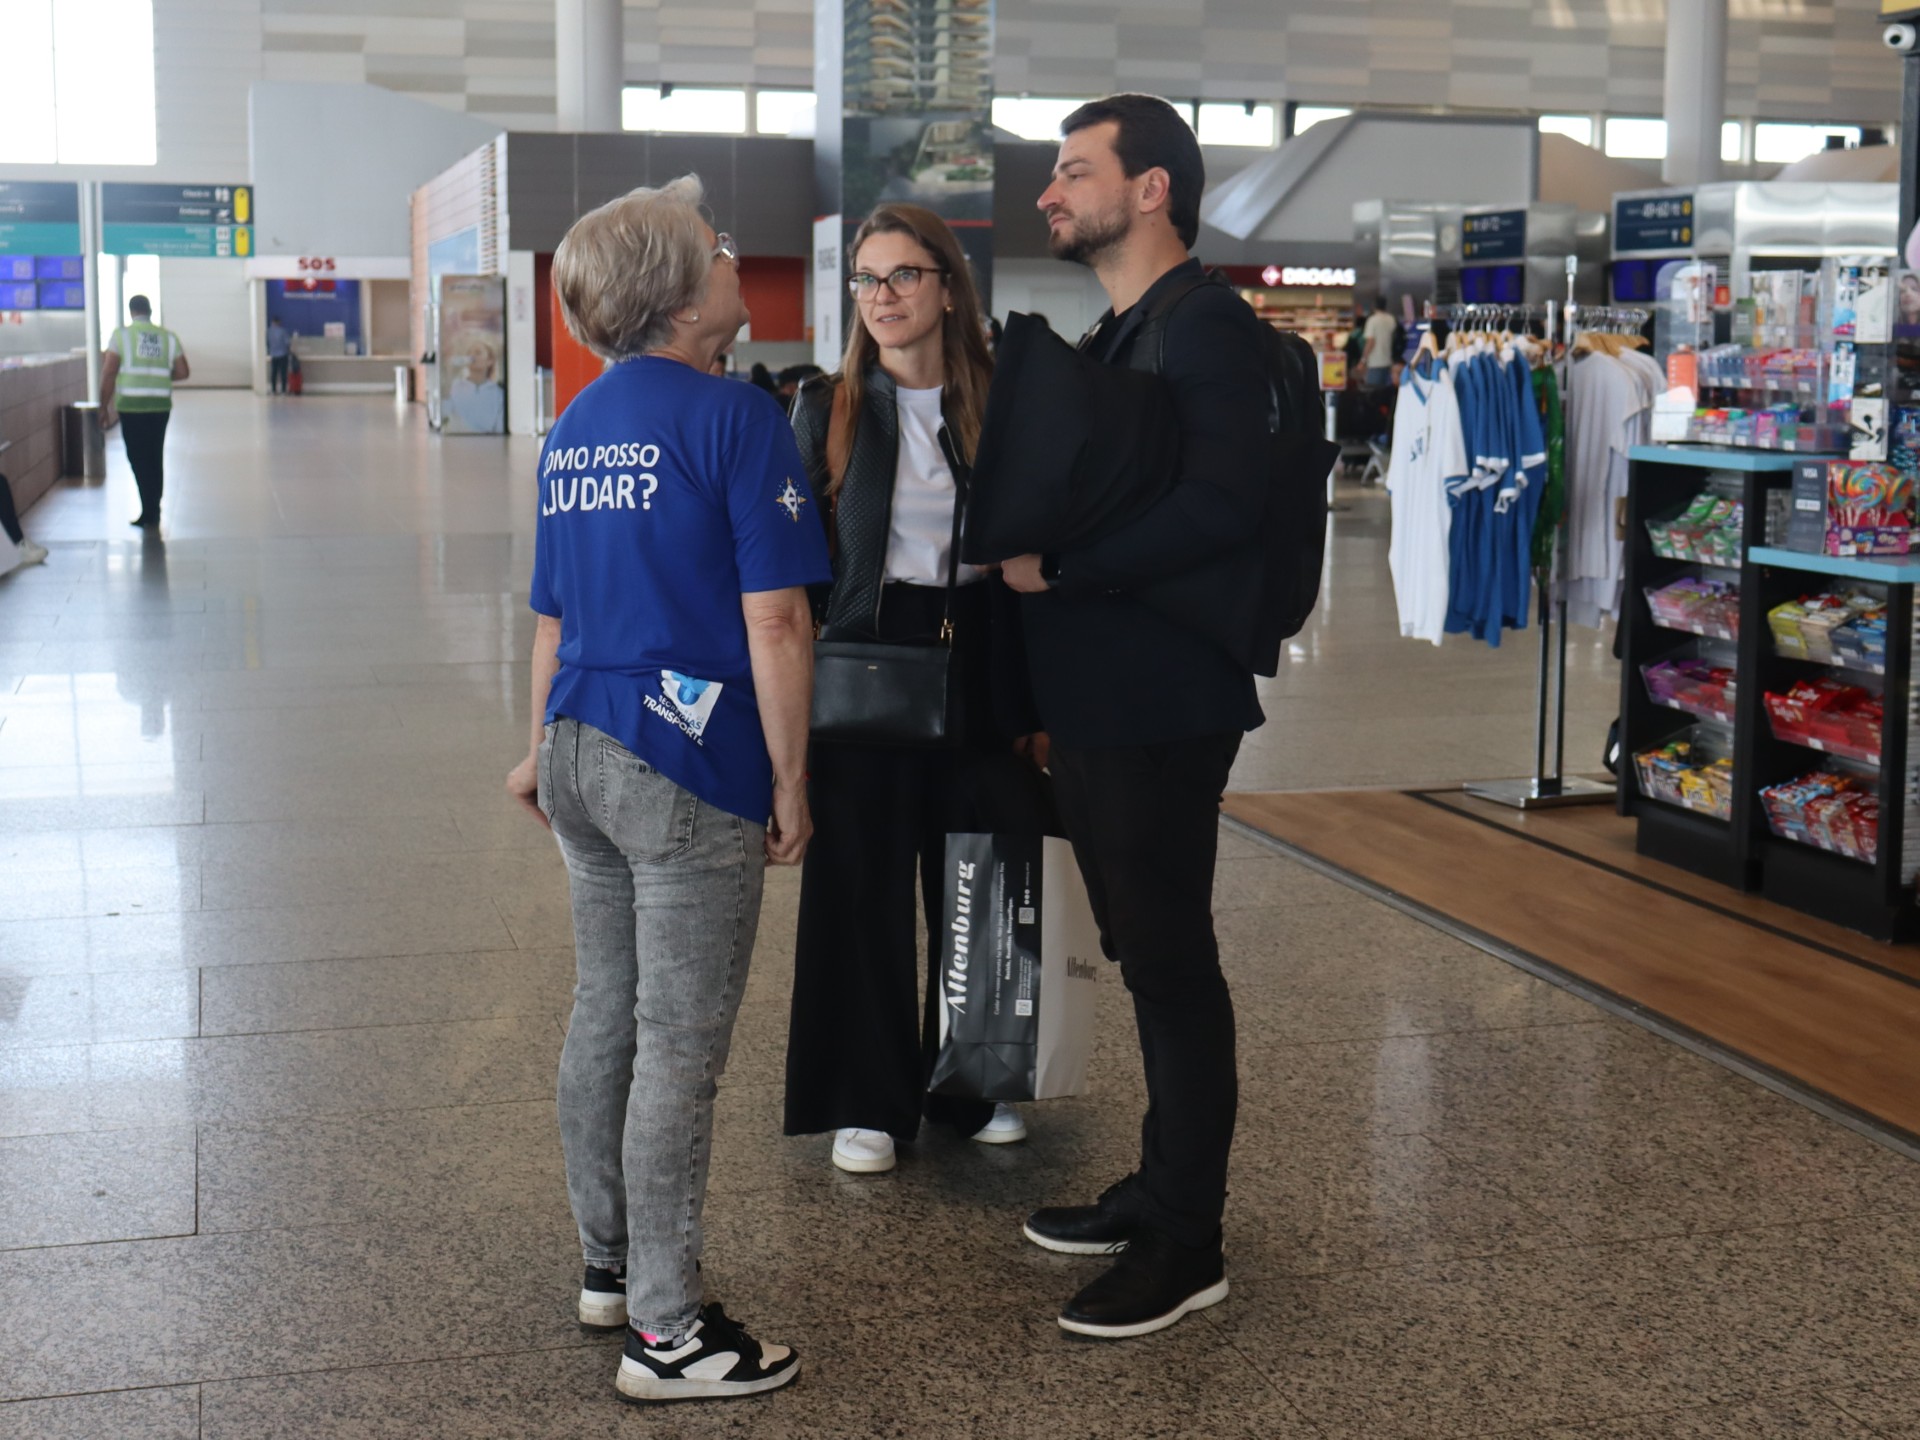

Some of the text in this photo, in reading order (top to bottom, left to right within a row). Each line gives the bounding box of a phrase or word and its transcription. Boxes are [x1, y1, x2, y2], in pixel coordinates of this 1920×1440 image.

[298, 257, 336, 271] SOS
[1281, 267, 1356, 286] DROGAS
[543, 442, 660, 477] OMO POSSO
[542, 472, 659, 517] JUDAR?
[643, 694, 705, 747] TRANSPORTE
[947, 859, 977, 1015] Altenburg
